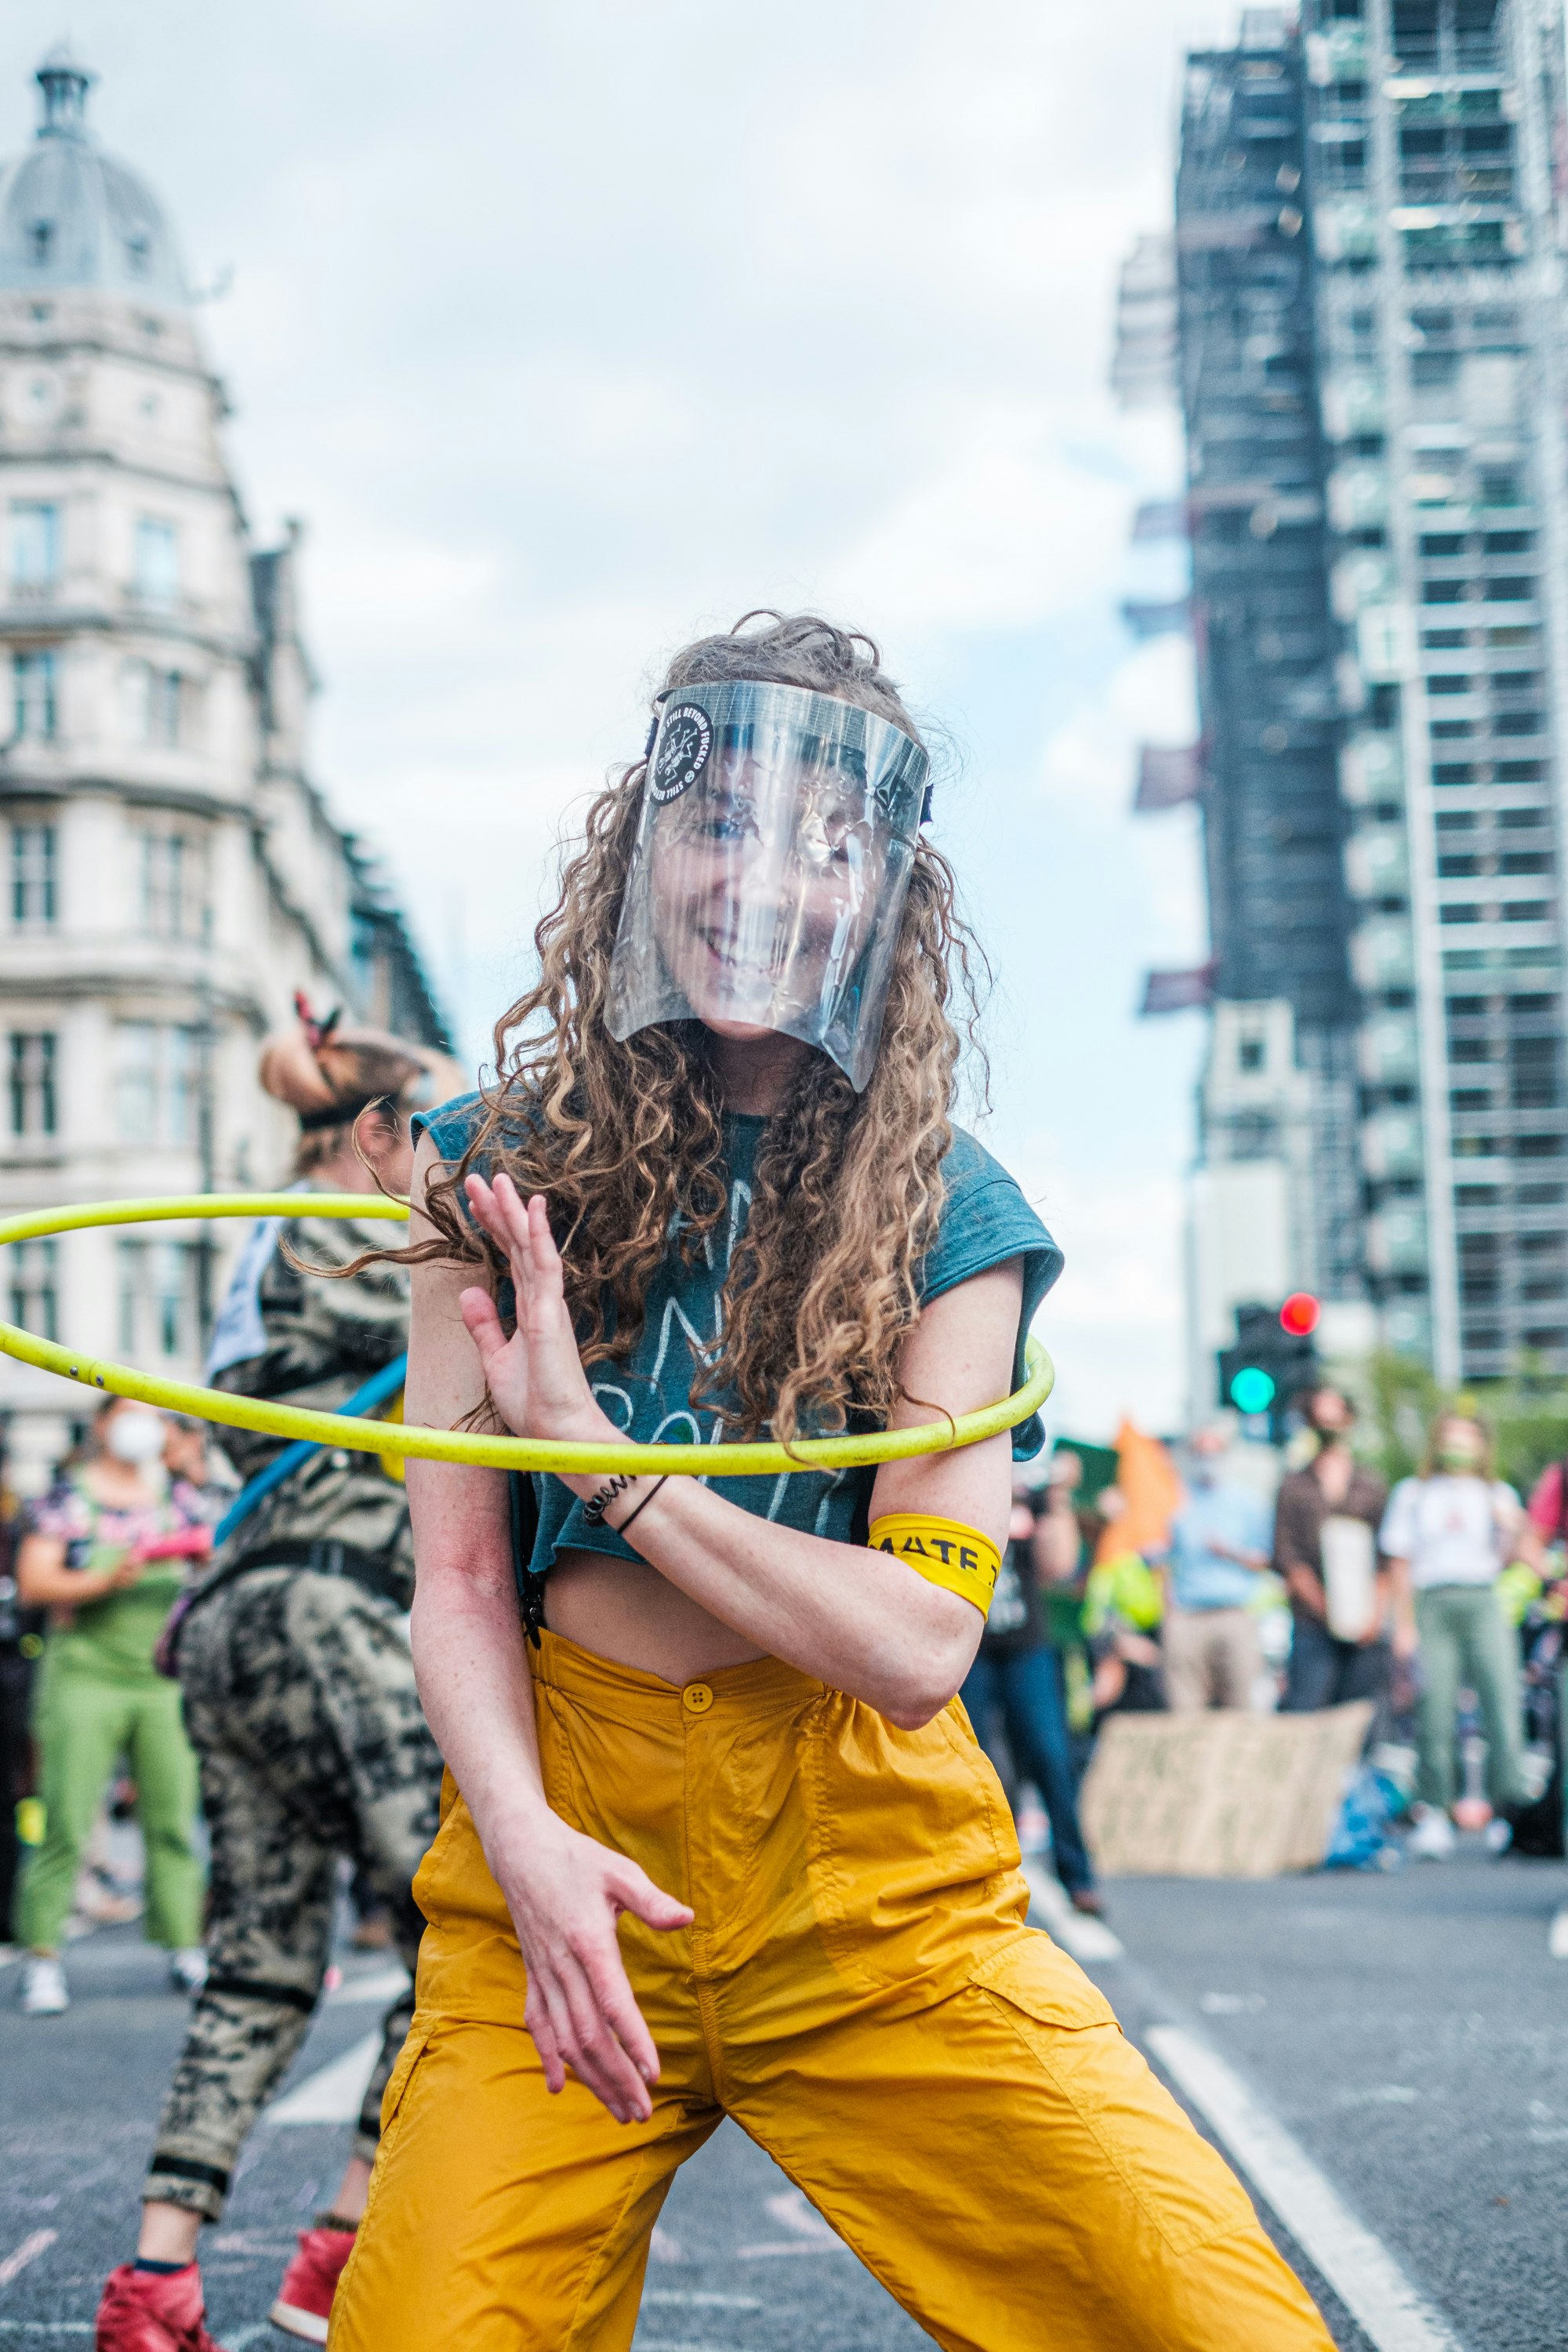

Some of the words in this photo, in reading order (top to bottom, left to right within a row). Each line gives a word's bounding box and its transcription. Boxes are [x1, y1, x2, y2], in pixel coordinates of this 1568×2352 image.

[666, 708, 681, 728] STILL
[683, 706, 708, 731] BEYOND
[693, 731, 710, 770] FUCKED
[666, 781, 684, 799] STILL
